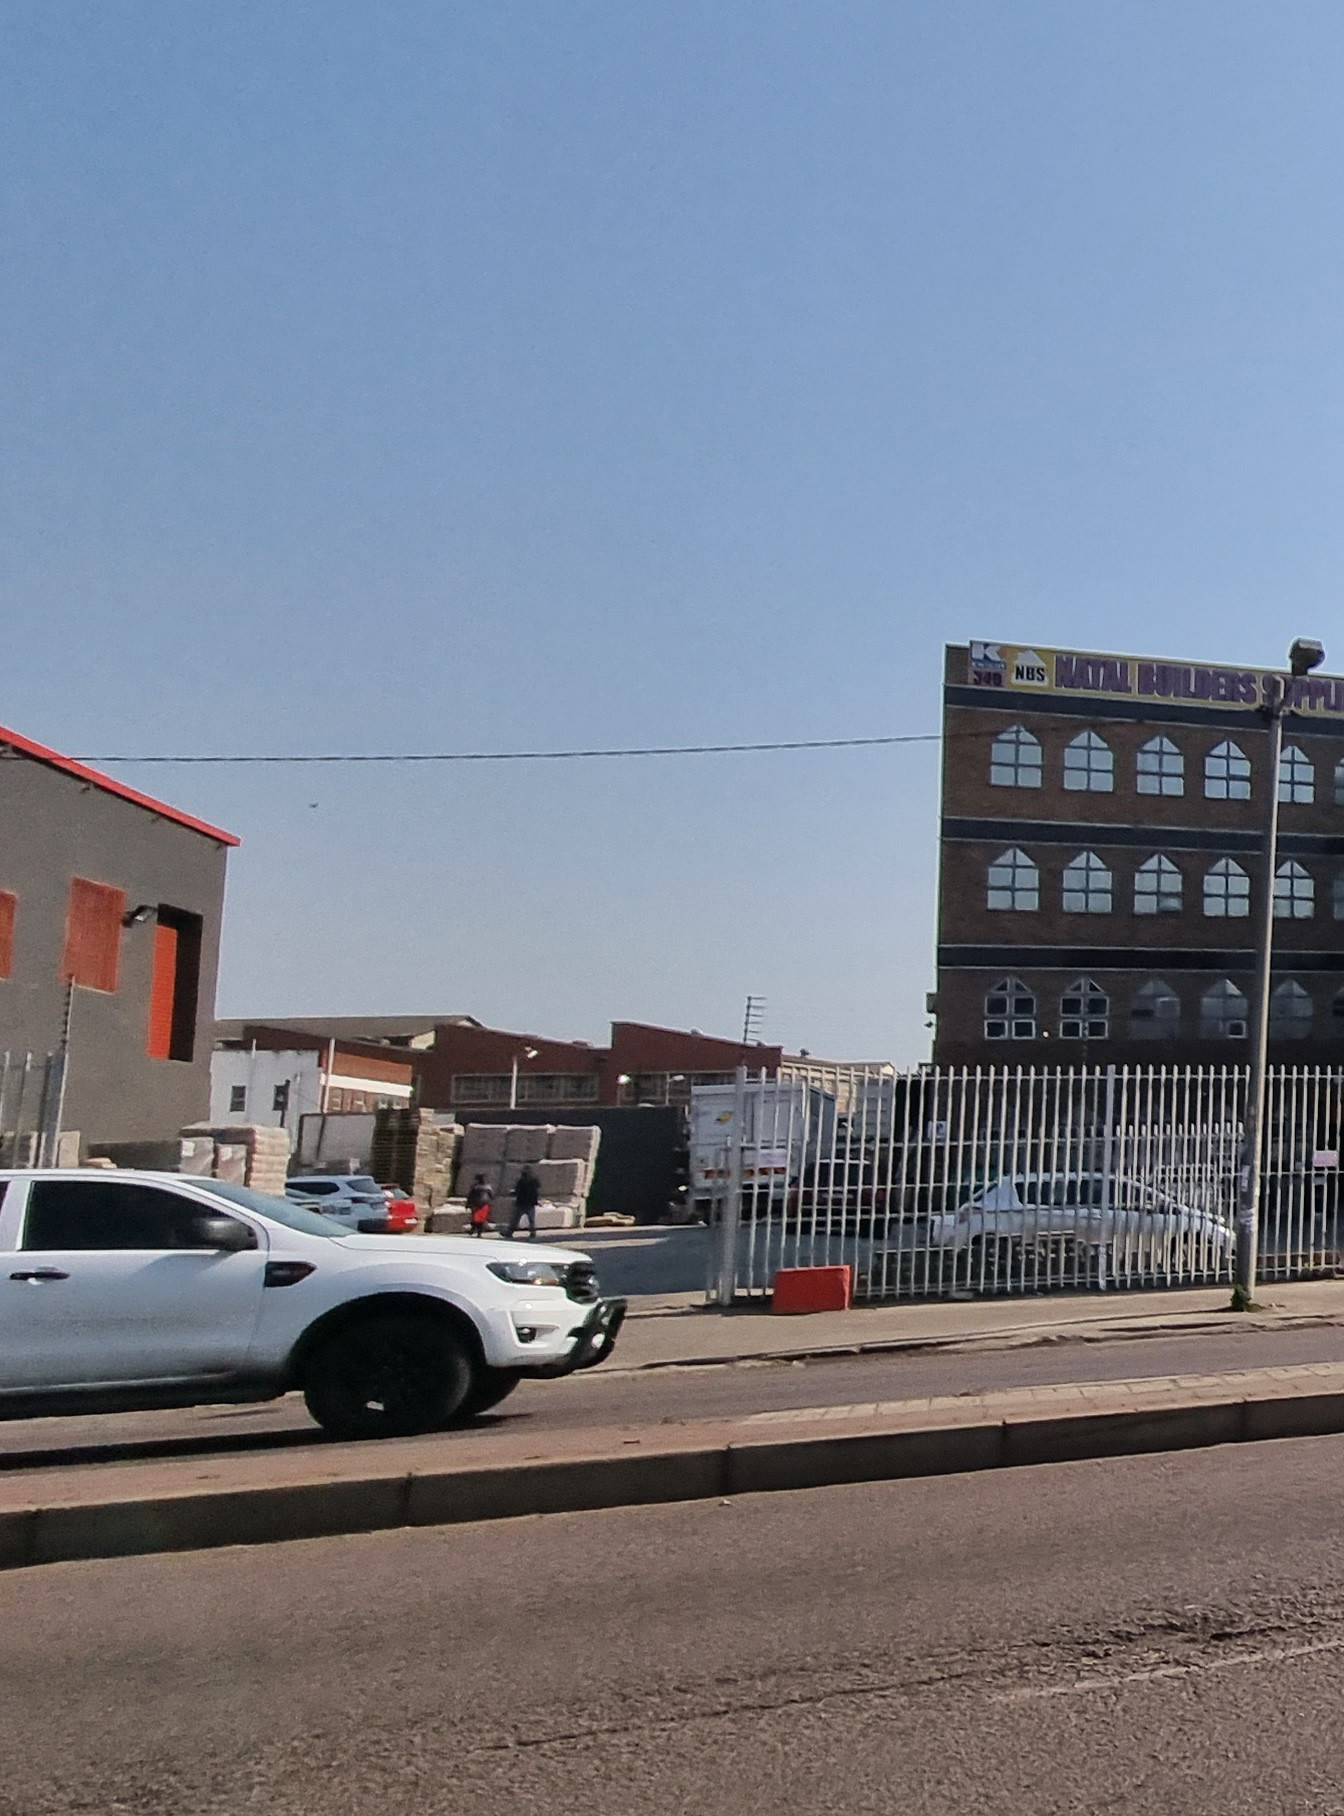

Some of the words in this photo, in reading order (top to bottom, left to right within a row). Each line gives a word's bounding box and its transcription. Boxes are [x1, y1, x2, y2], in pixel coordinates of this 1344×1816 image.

[1015, 665, 1045, 681] NBS
[1056, 655, 1133, 694] NATAL
[1138, 663, 1257, 704] BUILDERS
